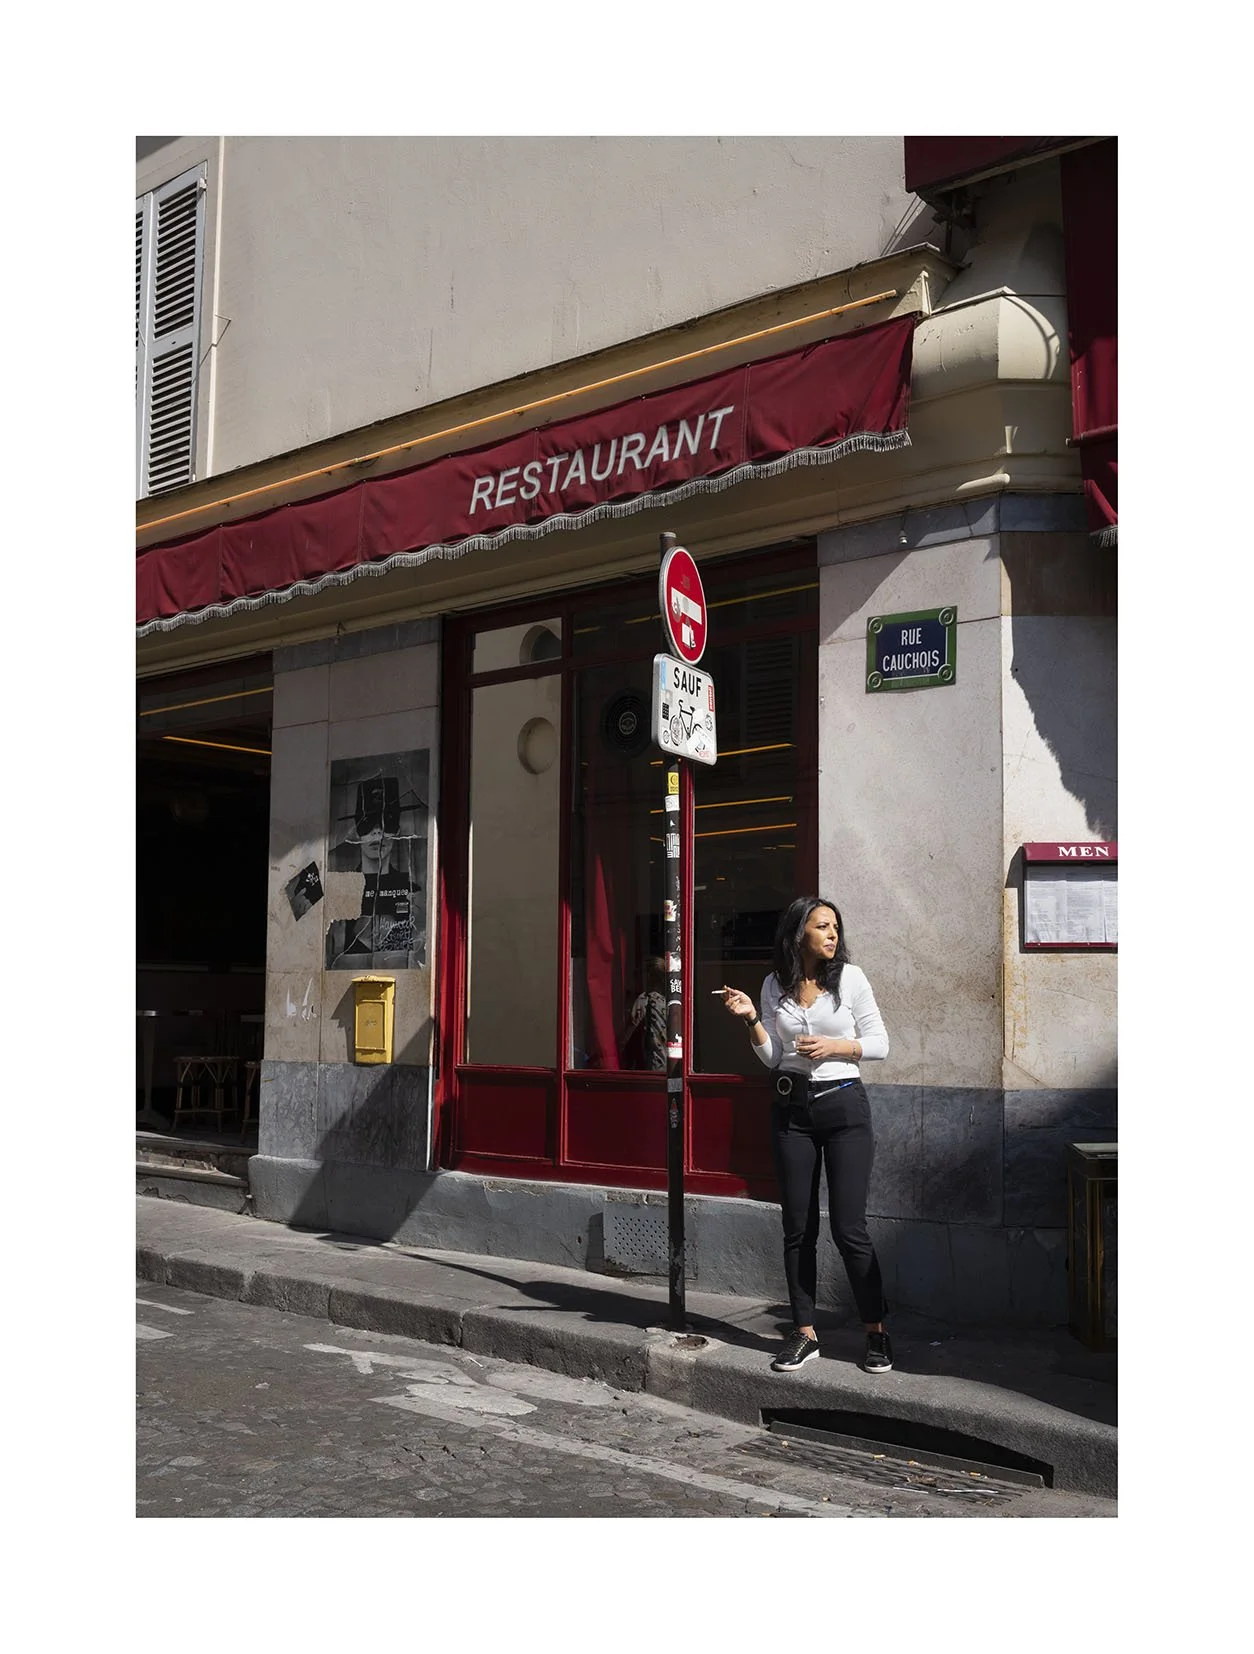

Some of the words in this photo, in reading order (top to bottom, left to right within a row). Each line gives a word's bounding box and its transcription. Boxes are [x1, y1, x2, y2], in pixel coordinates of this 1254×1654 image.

[468, 405, 735, 515] RESTAURANT
[901, 627, 922, 646] RUE
[882, 649, 940, 672] CAUCHOIS
[673, 666, 702, 697] SAUF
[1058, 846, 1110, 857] MEN
